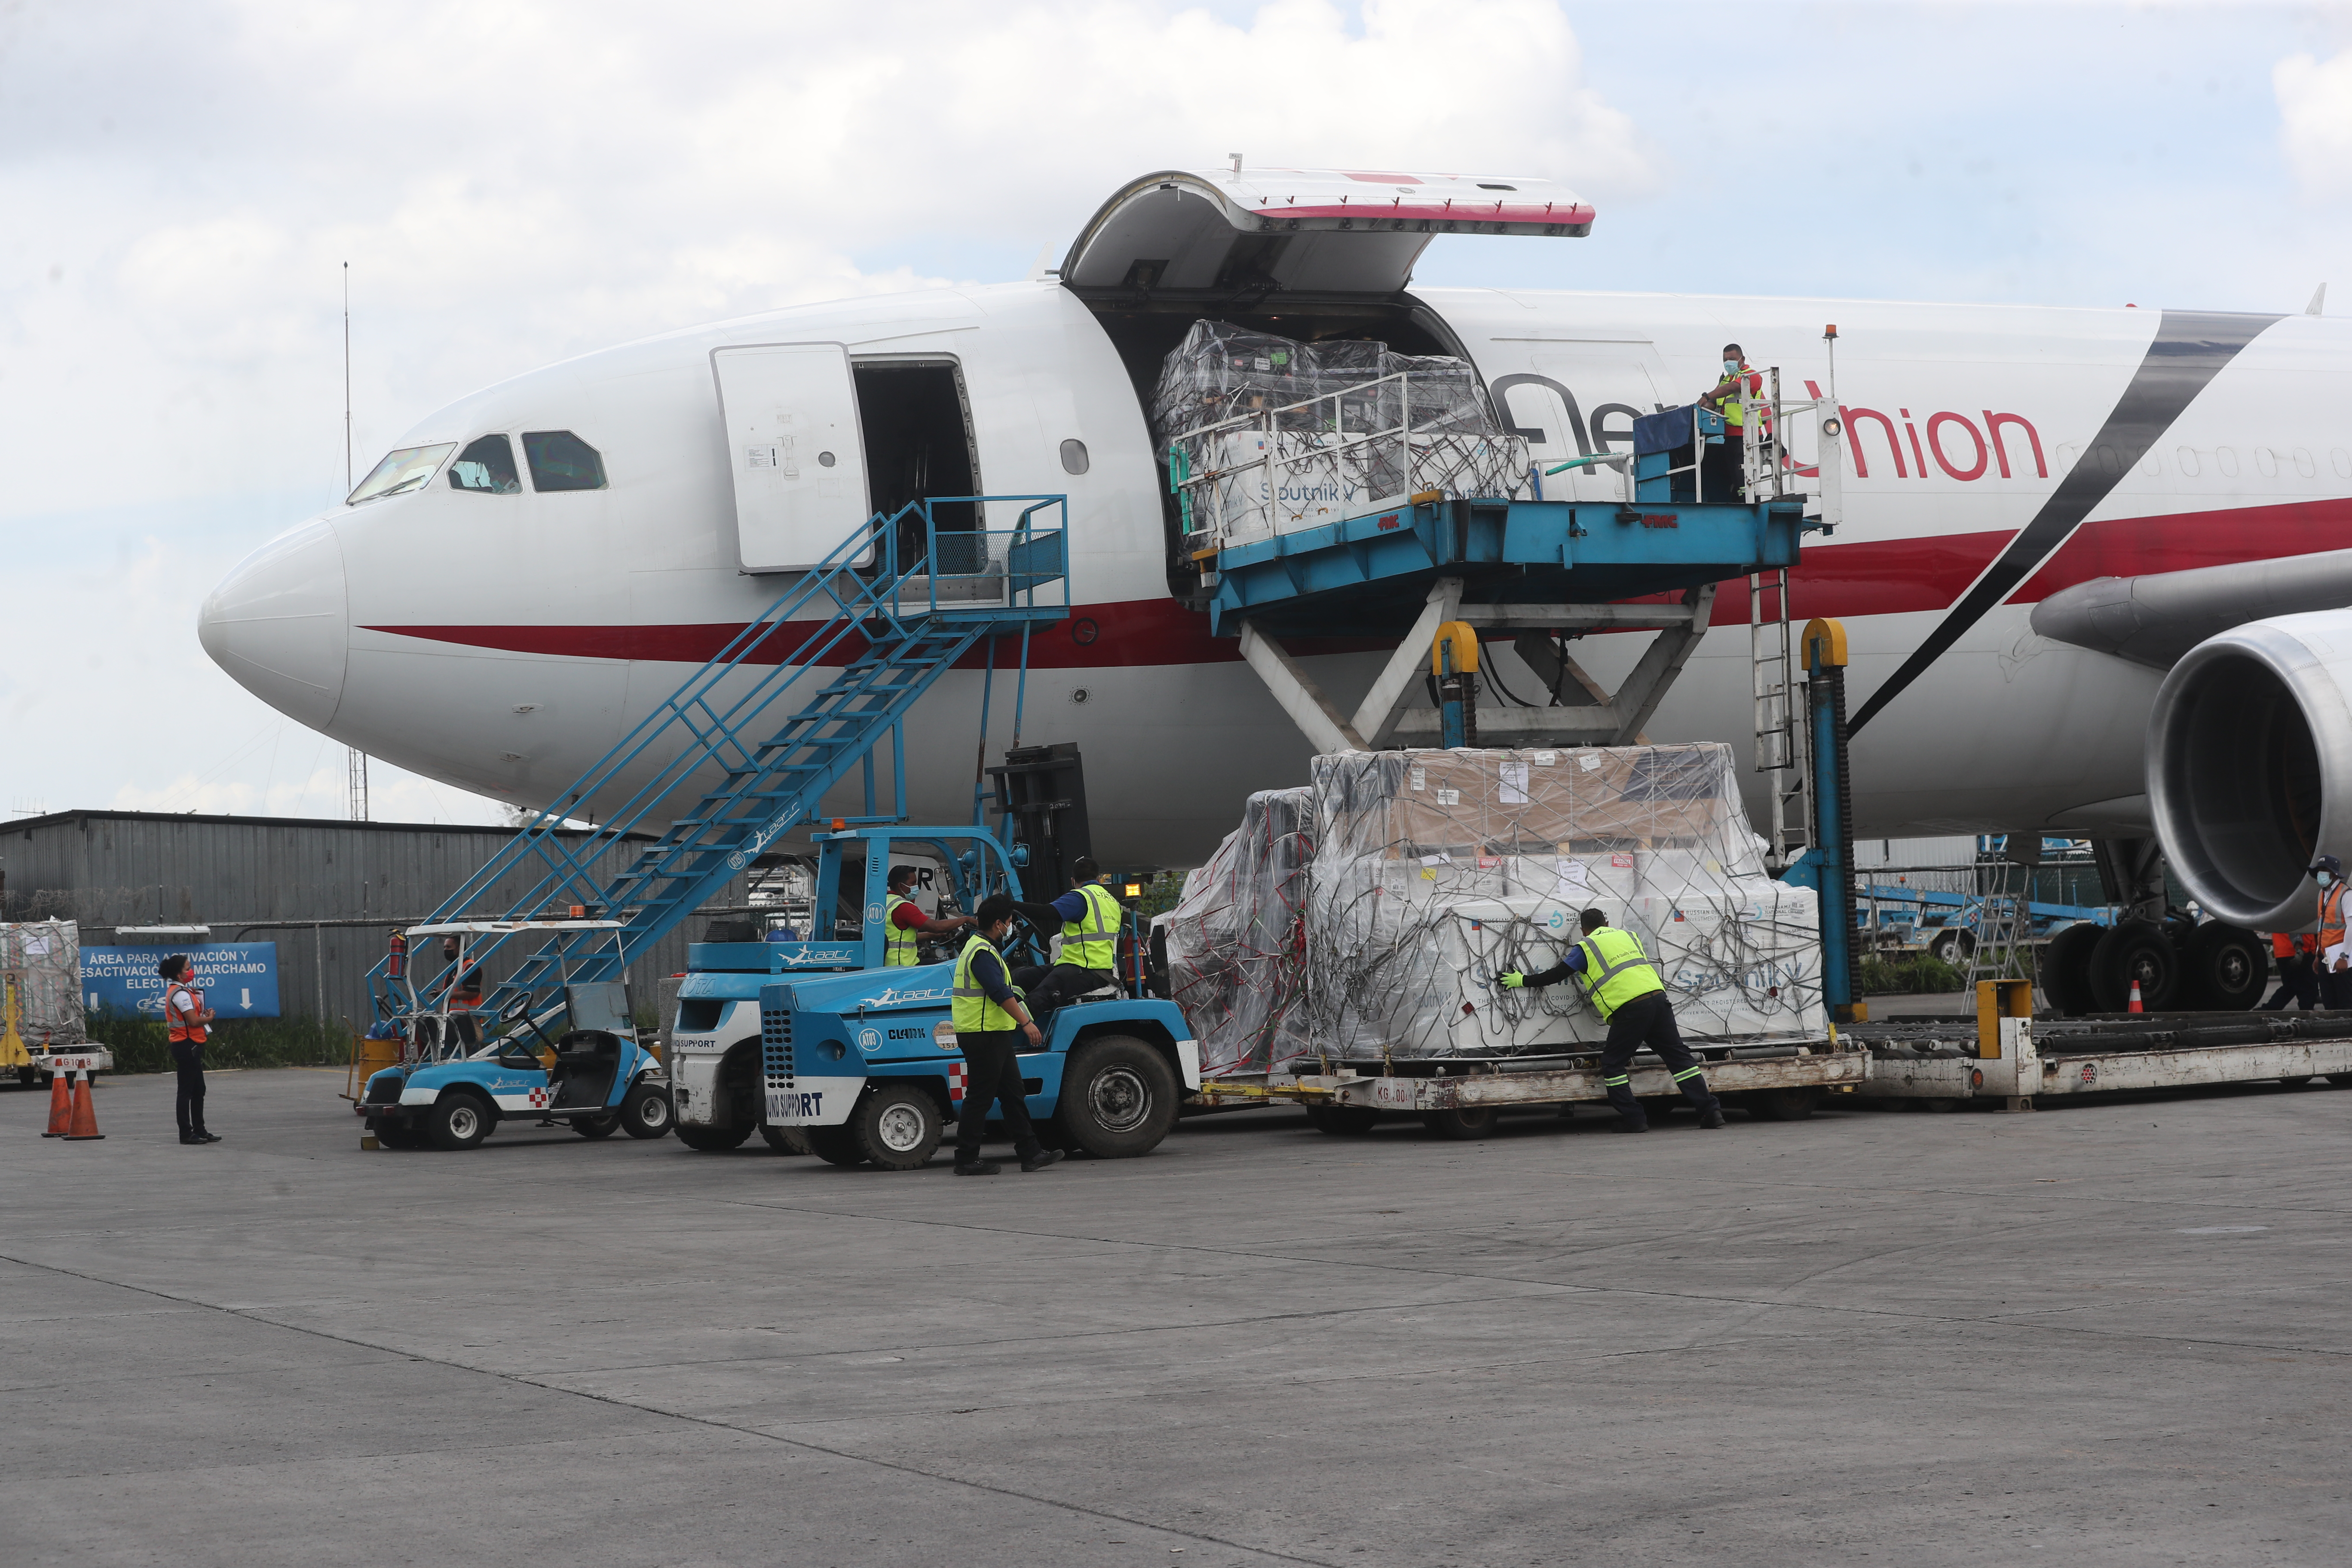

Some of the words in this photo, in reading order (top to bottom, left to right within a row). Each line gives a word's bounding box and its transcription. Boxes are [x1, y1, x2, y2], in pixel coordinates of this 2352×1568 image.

[1343, 484, 1356, 502] V
[1377, 514, 1400, 531] FMC
[1641, 514, 1677, 528] FMC
[868, 907, 882, 919] AT01
[89, 952, 124, 965] ÁREA
[127, 953, 159, 964] PARA
[162, 949, 237, 962] AIVACIÓN
[240, 951, 249, 961] Y
[80, 964, 160, 978] ESACTIVACIÓ
[194, 962, 266, 975] MARCHAMO
[1785, 962, 1802, 981] V
[681, 977, 717, 995] YOTA
[862, 1032, 877, 1047] AT03
[888, 1028, 926, 1040] CLARK
[1378, 1086, 1388, 1100] KG
[780, 1092, 823, 1118] SUPPORT
